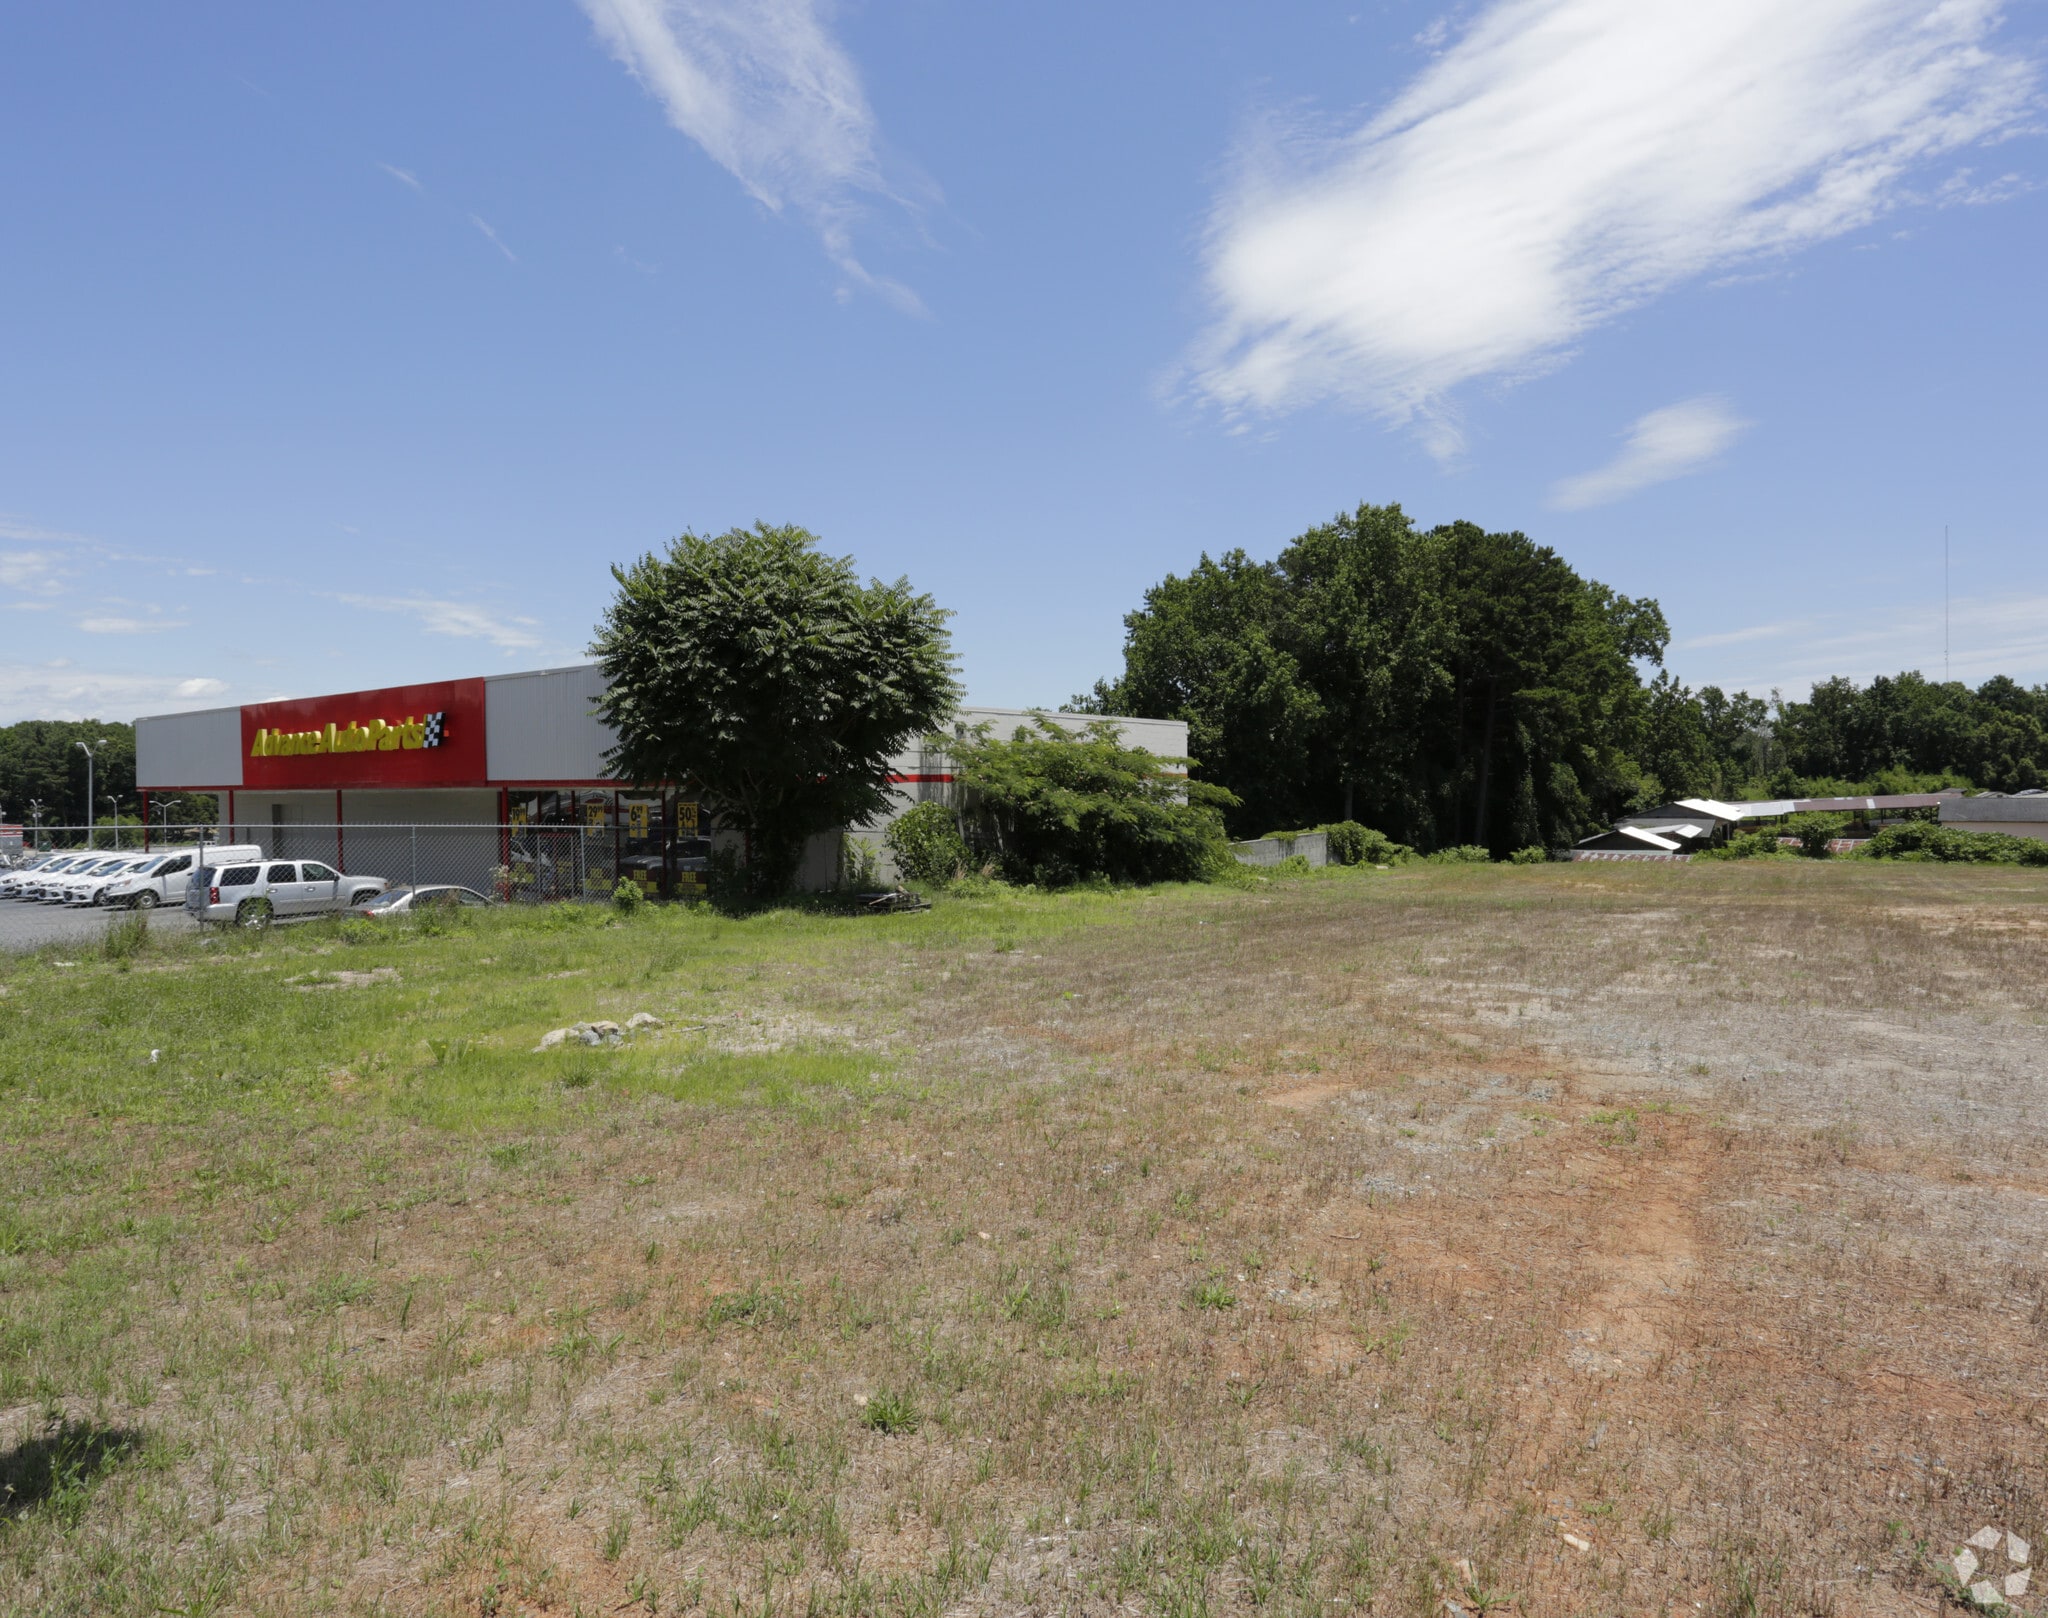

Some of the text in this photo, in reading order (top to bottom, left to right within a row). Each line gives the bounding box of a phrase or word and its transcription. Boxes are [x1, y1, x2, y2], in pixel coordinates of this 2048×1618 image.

[251, 715, 424, 756] Advance Auto Parts
[682, 871, 696, 882] FREE
